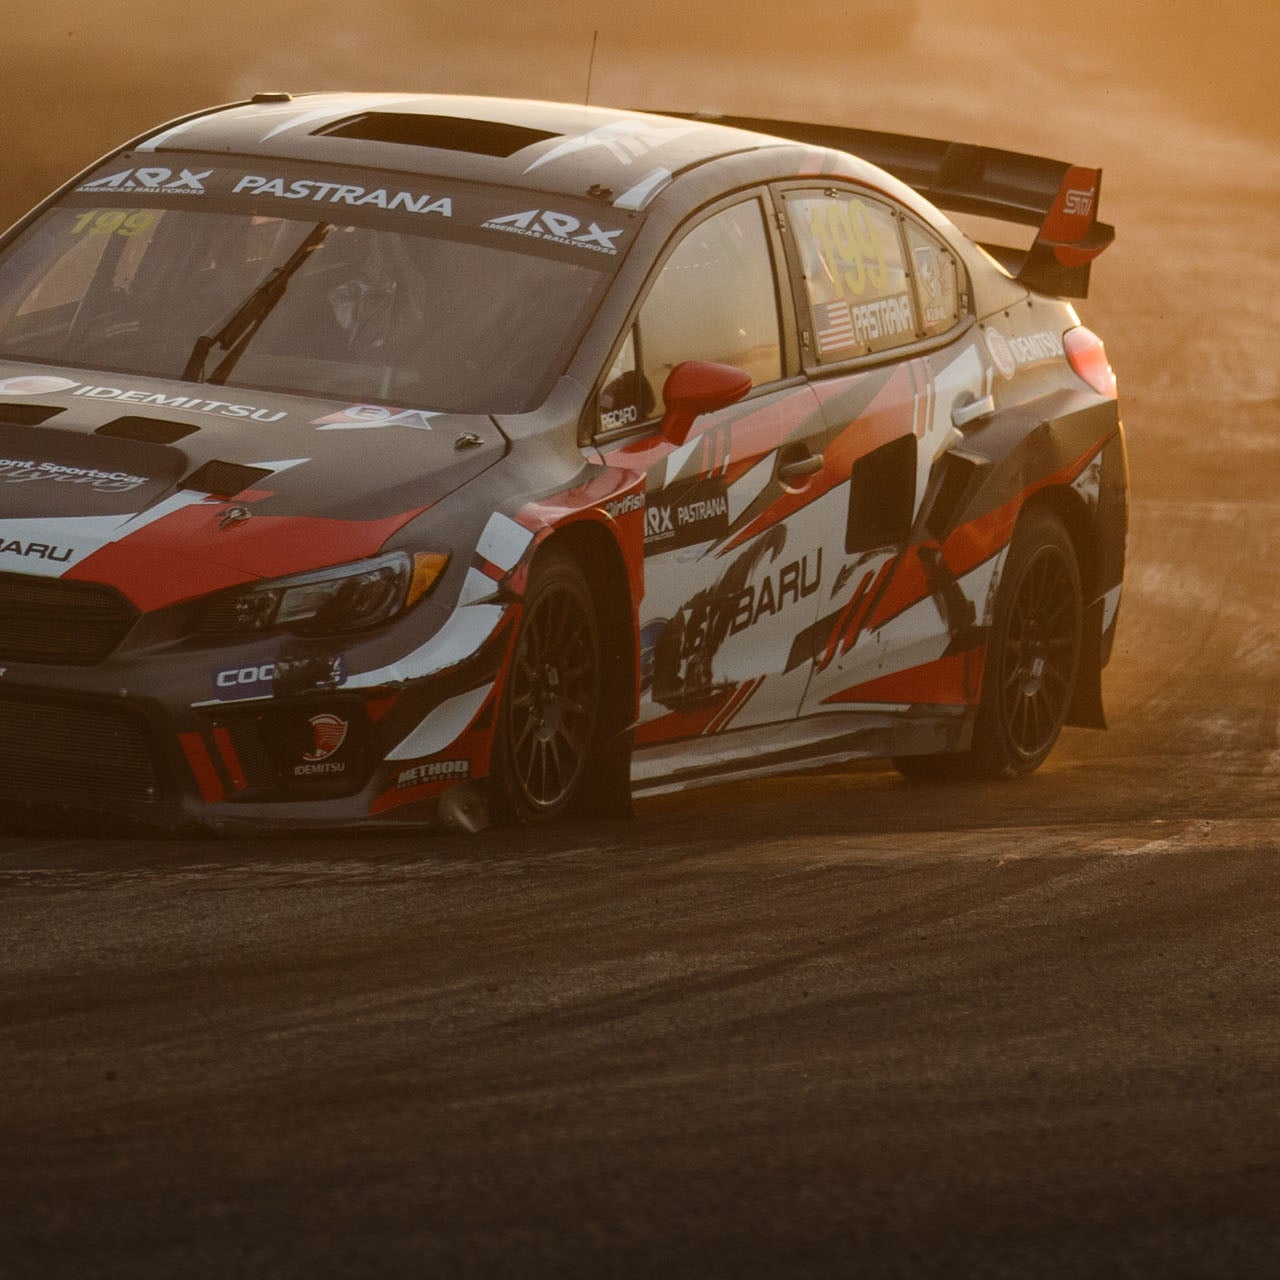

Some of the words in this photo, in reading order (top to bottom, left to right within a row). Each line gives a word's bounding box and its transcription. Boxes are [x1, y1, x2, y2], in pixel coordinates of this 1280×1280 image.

[82, 167, 214, 190] ARX
[232, 175, 453, 218] PASTRANA
[70, 209, 157, 237] 199
[486, 209, 624, 249] ARX
[481, 222, 541, 239] AMERICAS
[543, 234, 617, 255] RALLYCROSS
[810, 199, 887, 298] 199
[851, 294, 914, 346] PASTRANA
[73, 384, 287, 423] IDEMITSU
[600, 405, 637, 426] RECARO
[37, 461, 149, 484] SportsCar
[678, 496, 728, 525] PASTRANA
[294, 762, 345, 776] IDEMITSU
[398, 760, 469, 784] METHOD
